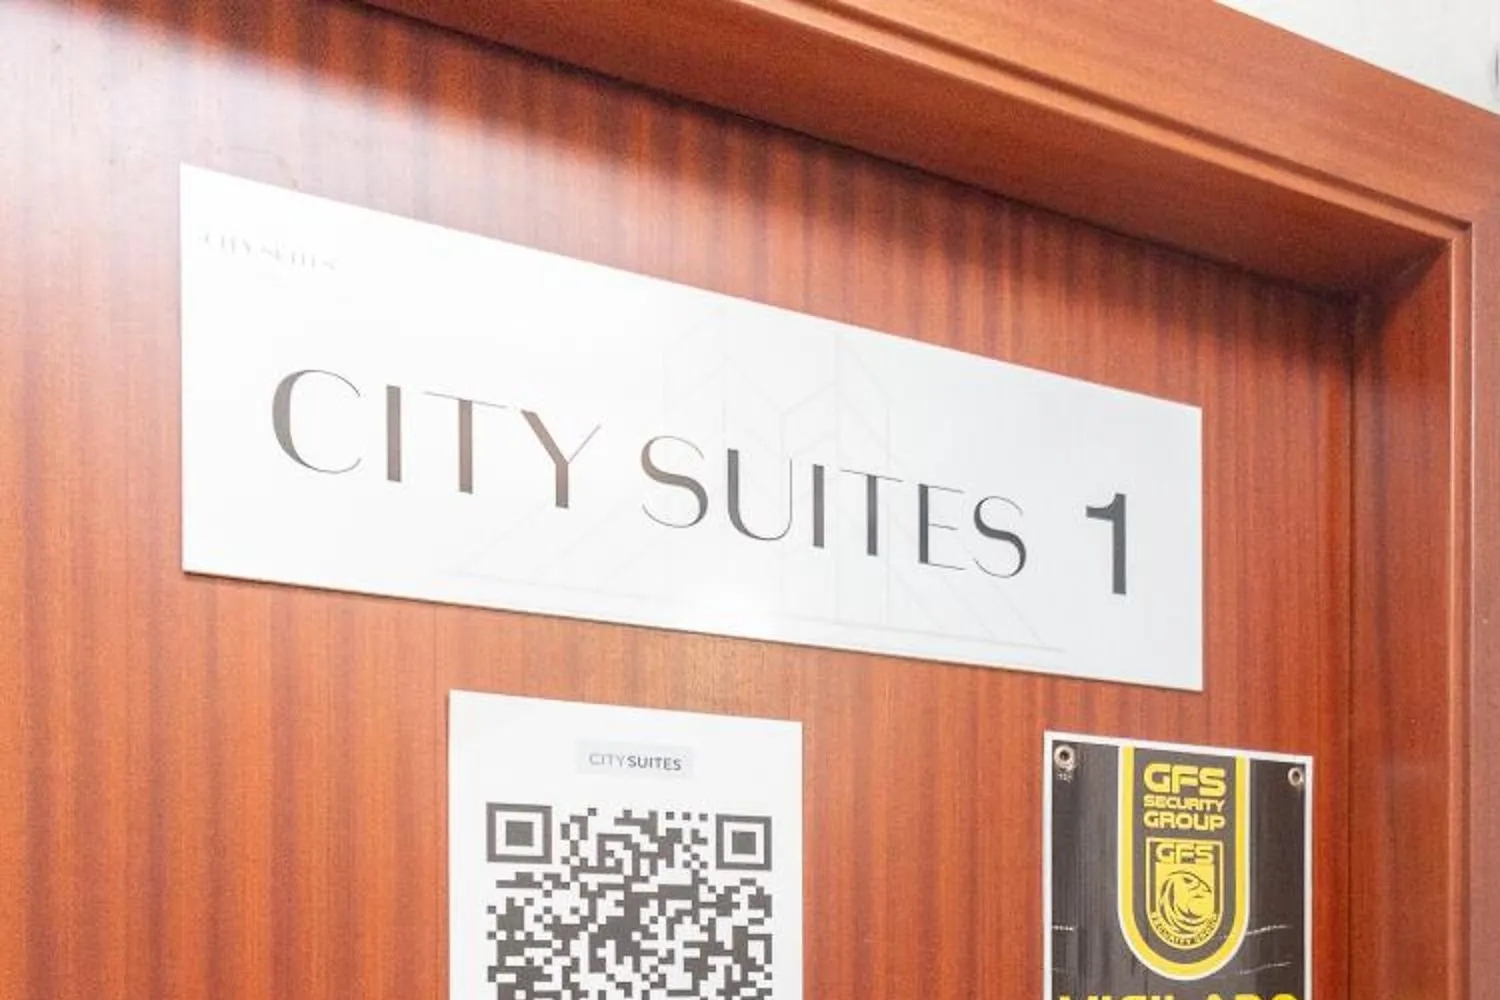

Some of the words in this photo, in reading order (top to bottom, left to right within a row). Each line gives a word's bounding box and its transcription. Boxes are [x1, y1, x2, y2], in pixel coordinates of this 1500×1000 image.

[271, 368, 601, 509] CITY
[639, 434, 1028, 579] SUITES
[1085, 492, 1128, 595] 1
[588, 752, 682, 771] CITYSUITES
[1143, 763, 1226, 797] GFS
[1143, 795, 1225, 812] SECURITY
[1143, 811, 1226, 831] GROUP
[1155, 843, 1214, 864] GFS
